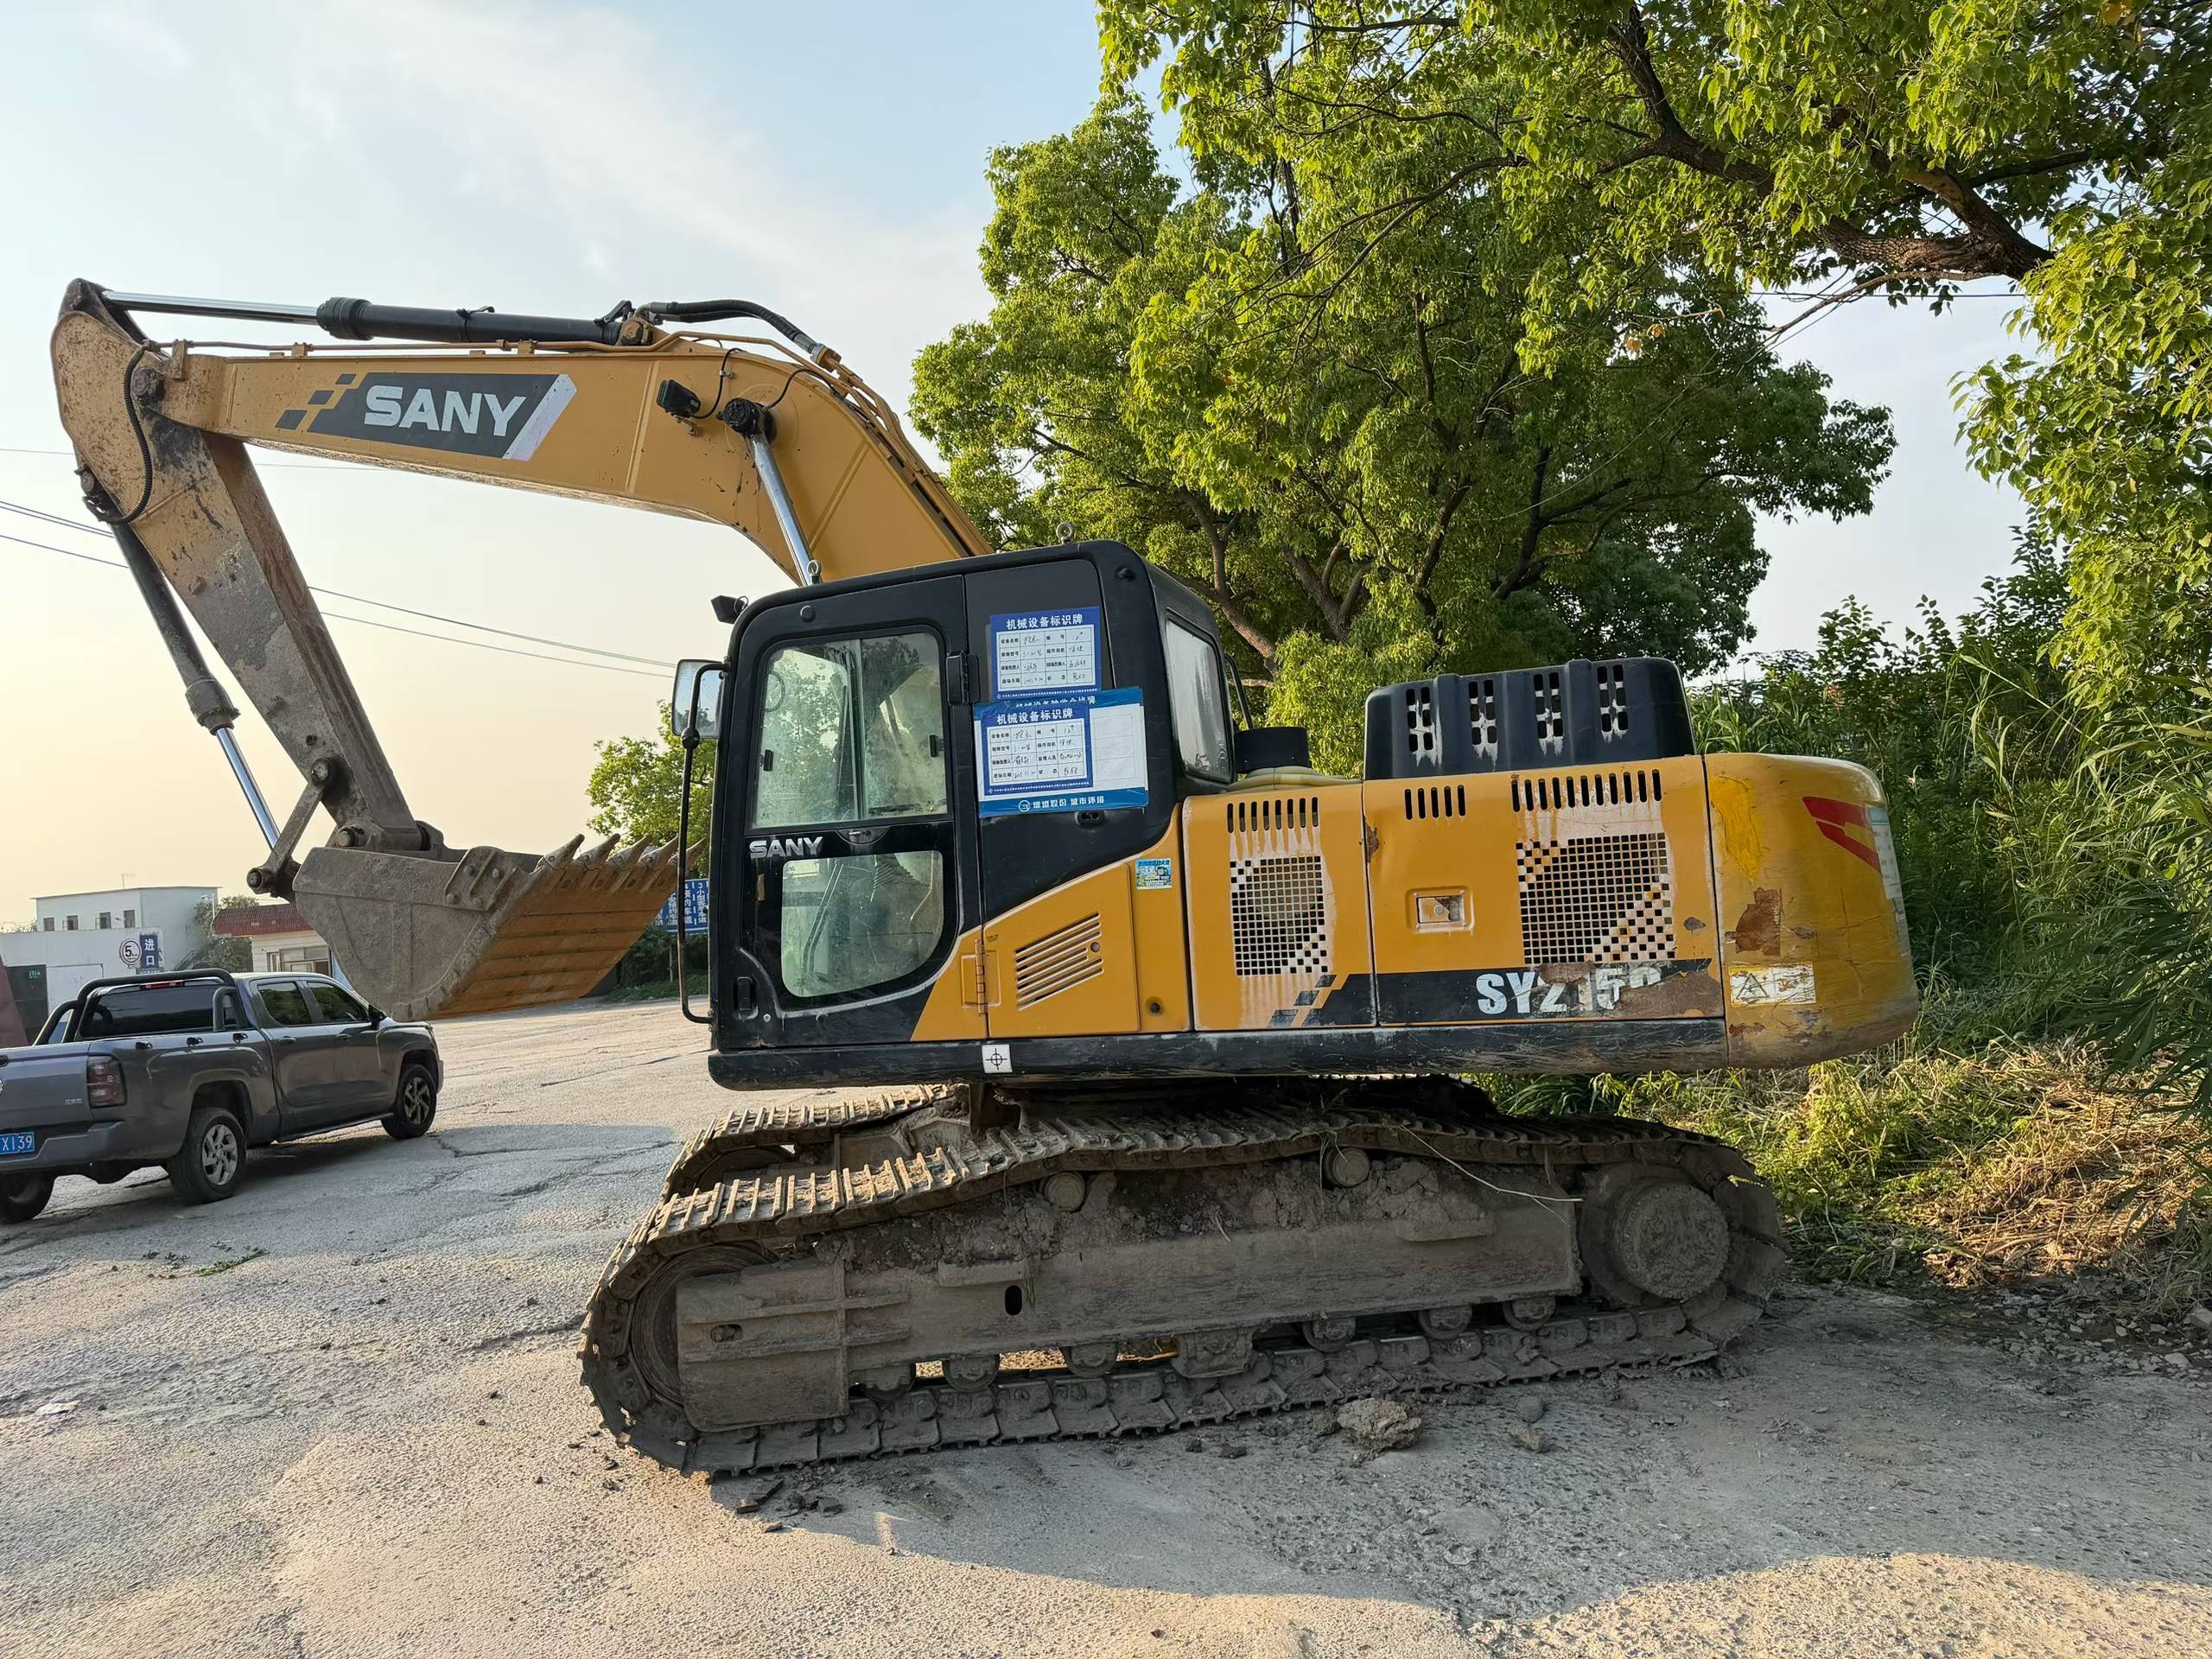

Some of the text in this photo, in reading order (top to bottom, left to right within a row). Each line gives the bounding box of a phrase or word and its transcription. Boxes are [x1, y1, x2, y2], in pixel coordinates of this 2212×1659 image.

[364, 385, 527, 436] SANY
[1006, 613, 1084, 630] 机械设备标识牌
[996, 708, 1074, 725] 机械设备标识牌
[1033, 795, 1105, 810] 隧道股份 城市环境
[749, 836, 823, 859] SANY
[124, 945, 132, 957] 5
[144, 938, 156, 966] 进口
[0, 1135, 33, 1151] X139
